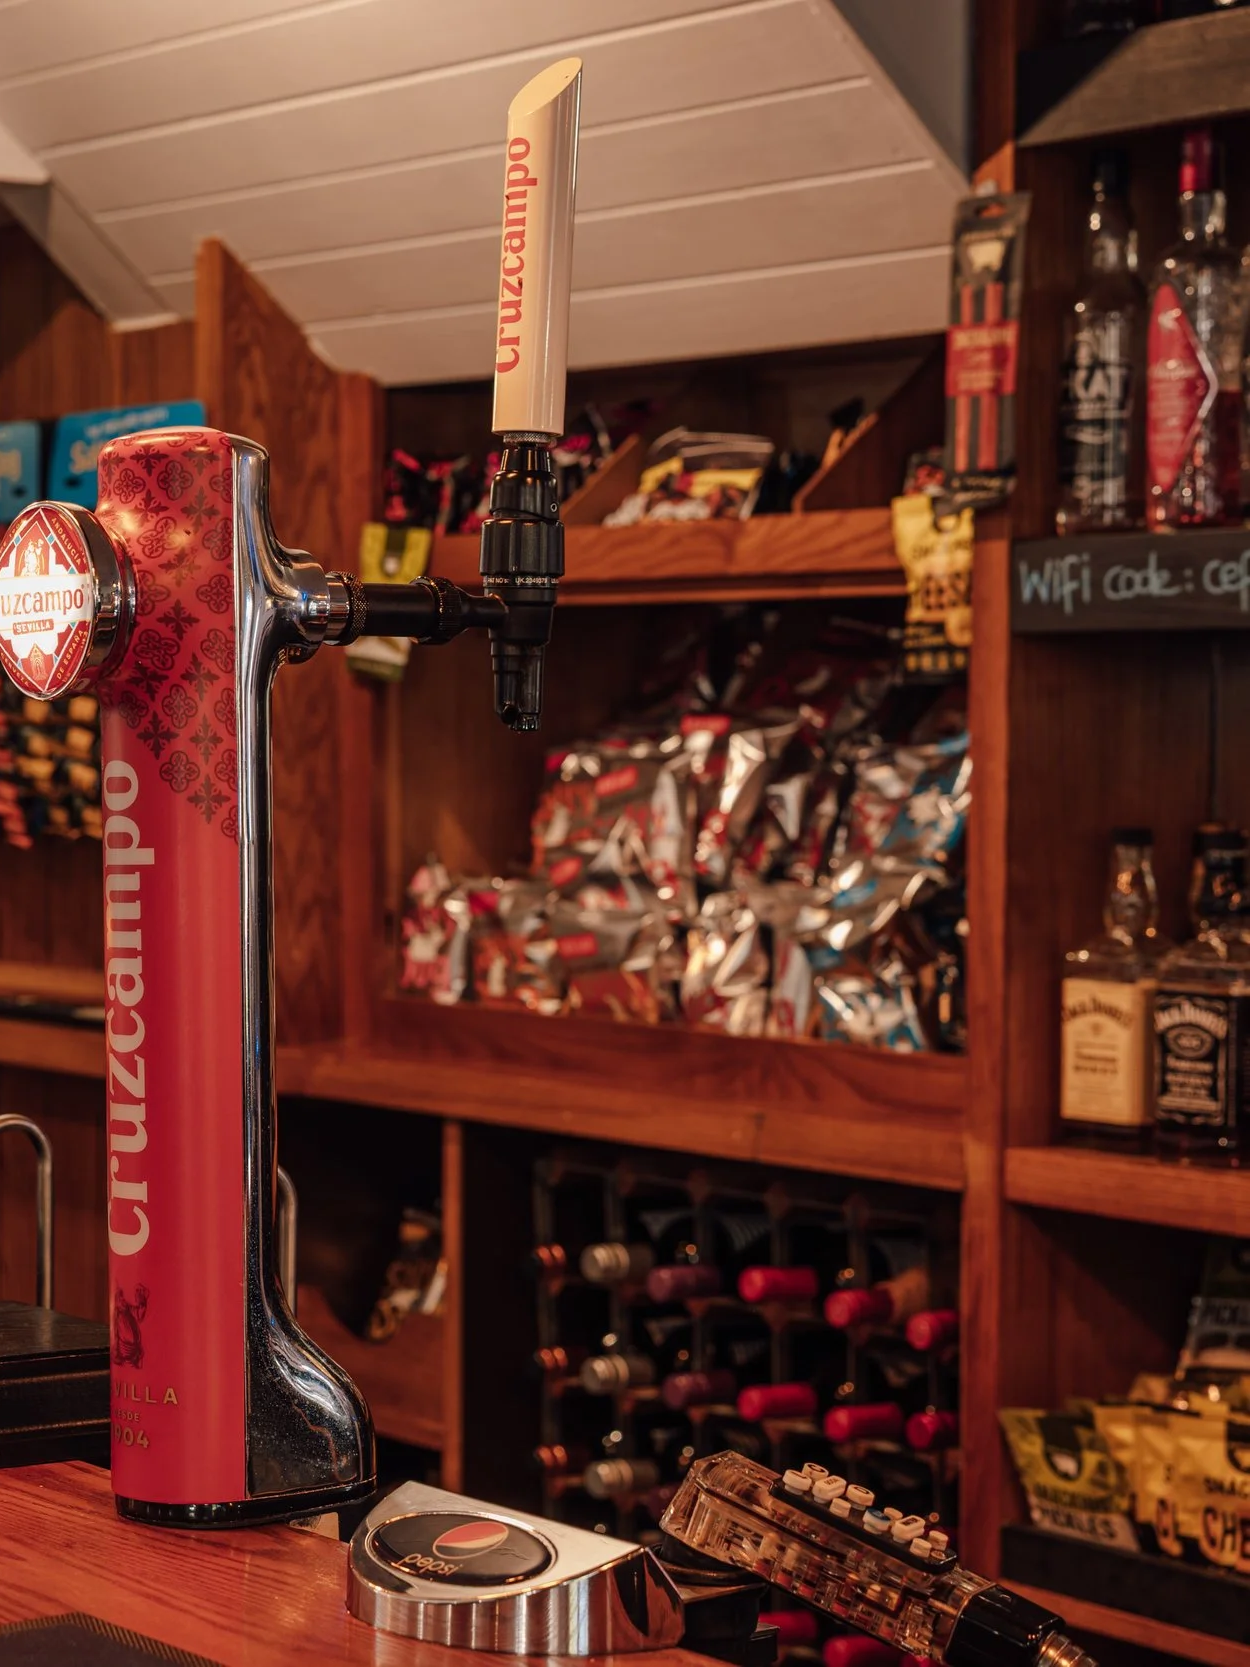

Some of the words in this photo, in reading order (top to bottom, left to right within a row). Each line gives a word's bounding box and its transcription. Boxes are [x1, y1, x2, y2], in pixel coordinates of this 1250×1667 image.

[495, 137, 538, 374] cruzcampo
[16, 623, 51, 634] SEVILLA
[57, 666, 65, 679] DE
[65, 629, 85, 665] ESPAÑA
[103, 760, 155, 1257] cruzcampo
[395, 1553, 463, 1576] pepsi
